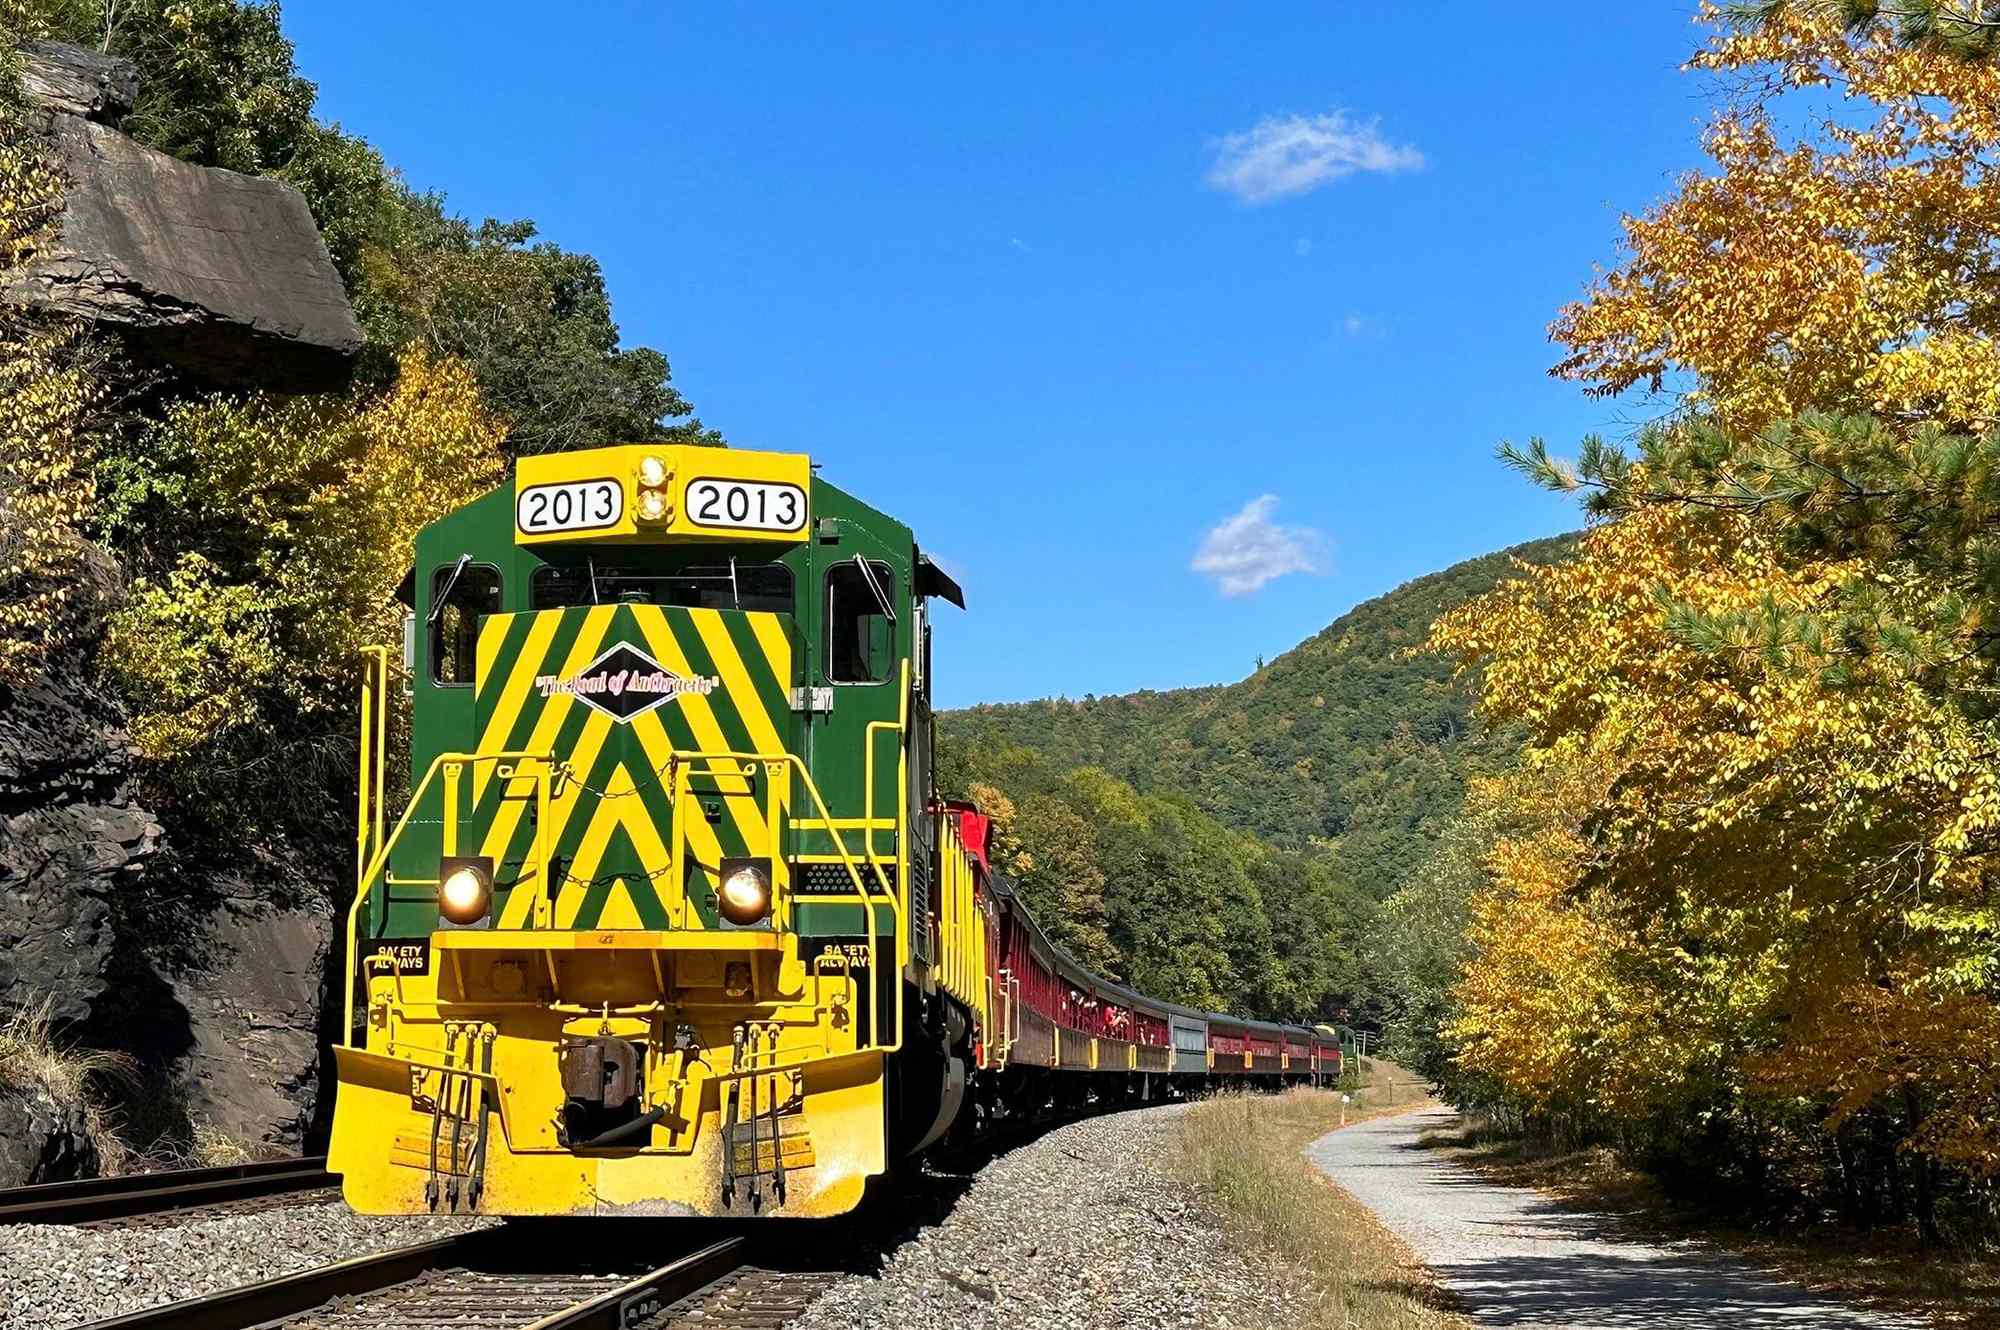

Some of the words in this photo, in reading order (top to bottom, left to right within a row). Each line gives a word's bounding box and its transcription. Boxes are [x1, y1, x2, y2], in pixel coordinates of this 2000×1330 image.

[528, 485, 613, 527] 2013
[698, 485, 797, 526] 2013
[608, 670, 629, 696] of
